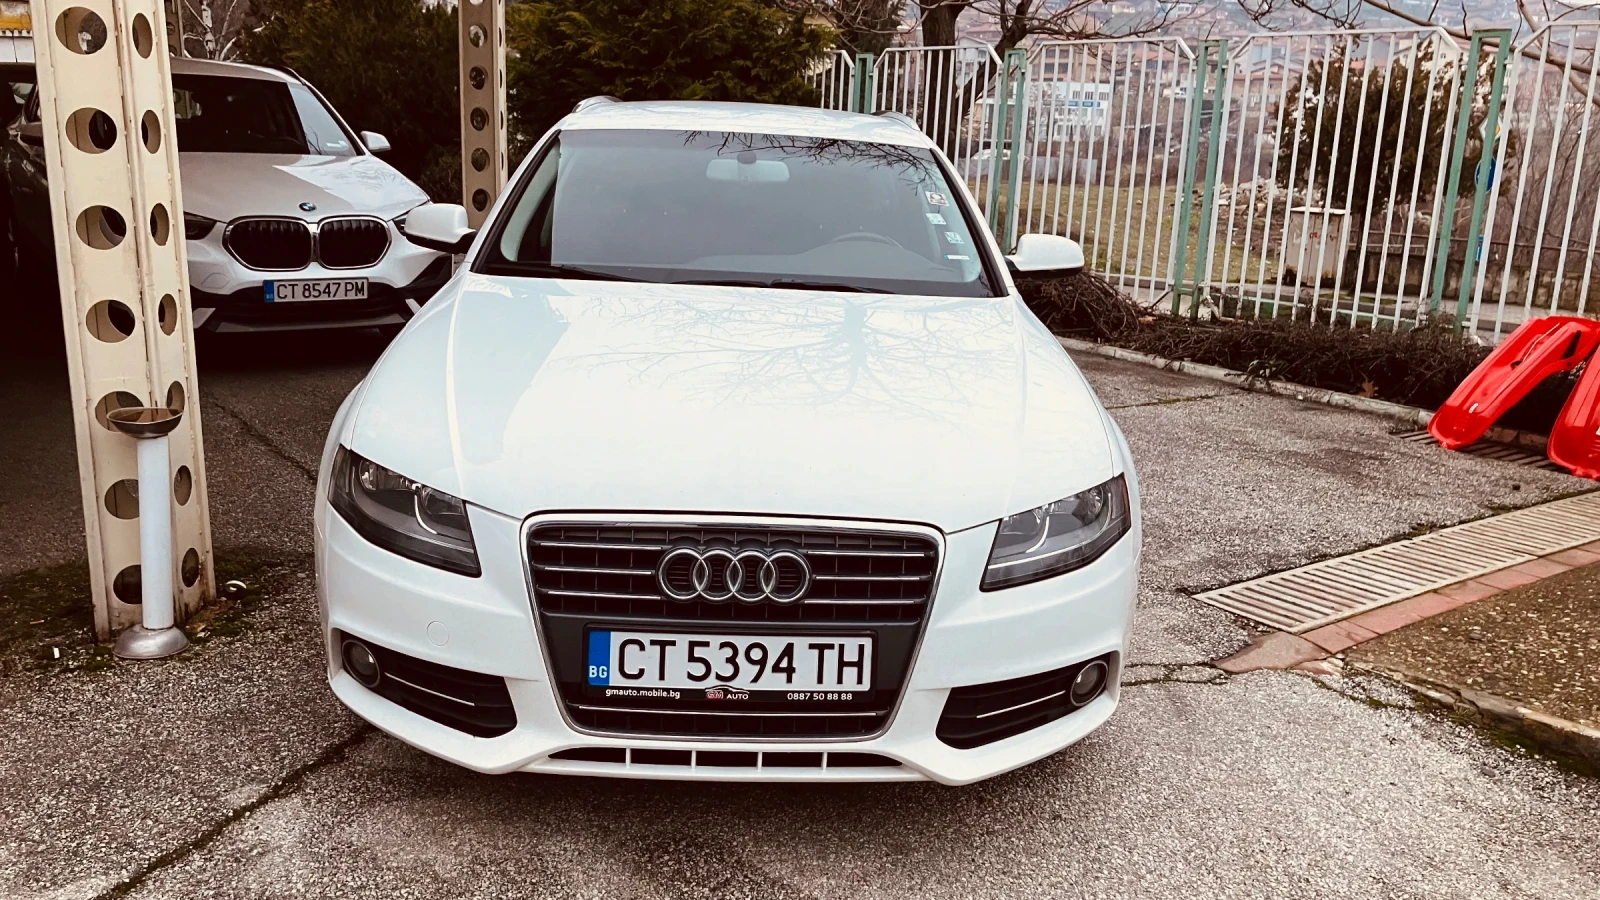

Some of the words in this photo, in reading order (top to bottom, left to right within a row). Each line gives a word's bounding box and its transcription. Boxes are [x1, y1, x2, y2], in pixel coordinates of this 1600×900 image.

[277, 283, 298, 299] CT
[302, 282, 341, 298] 8547
[344, 281, 365, 297] PM
[618, 638, 676, 681] CT
[686, 640, 796, 684] 5394
[808, 643, 865, 685] TH
[589, 665, 608, 678] BG
[605, 688, 680, 699] gmauto.mobile.bg
[787, 692, 810, 700] 0887
